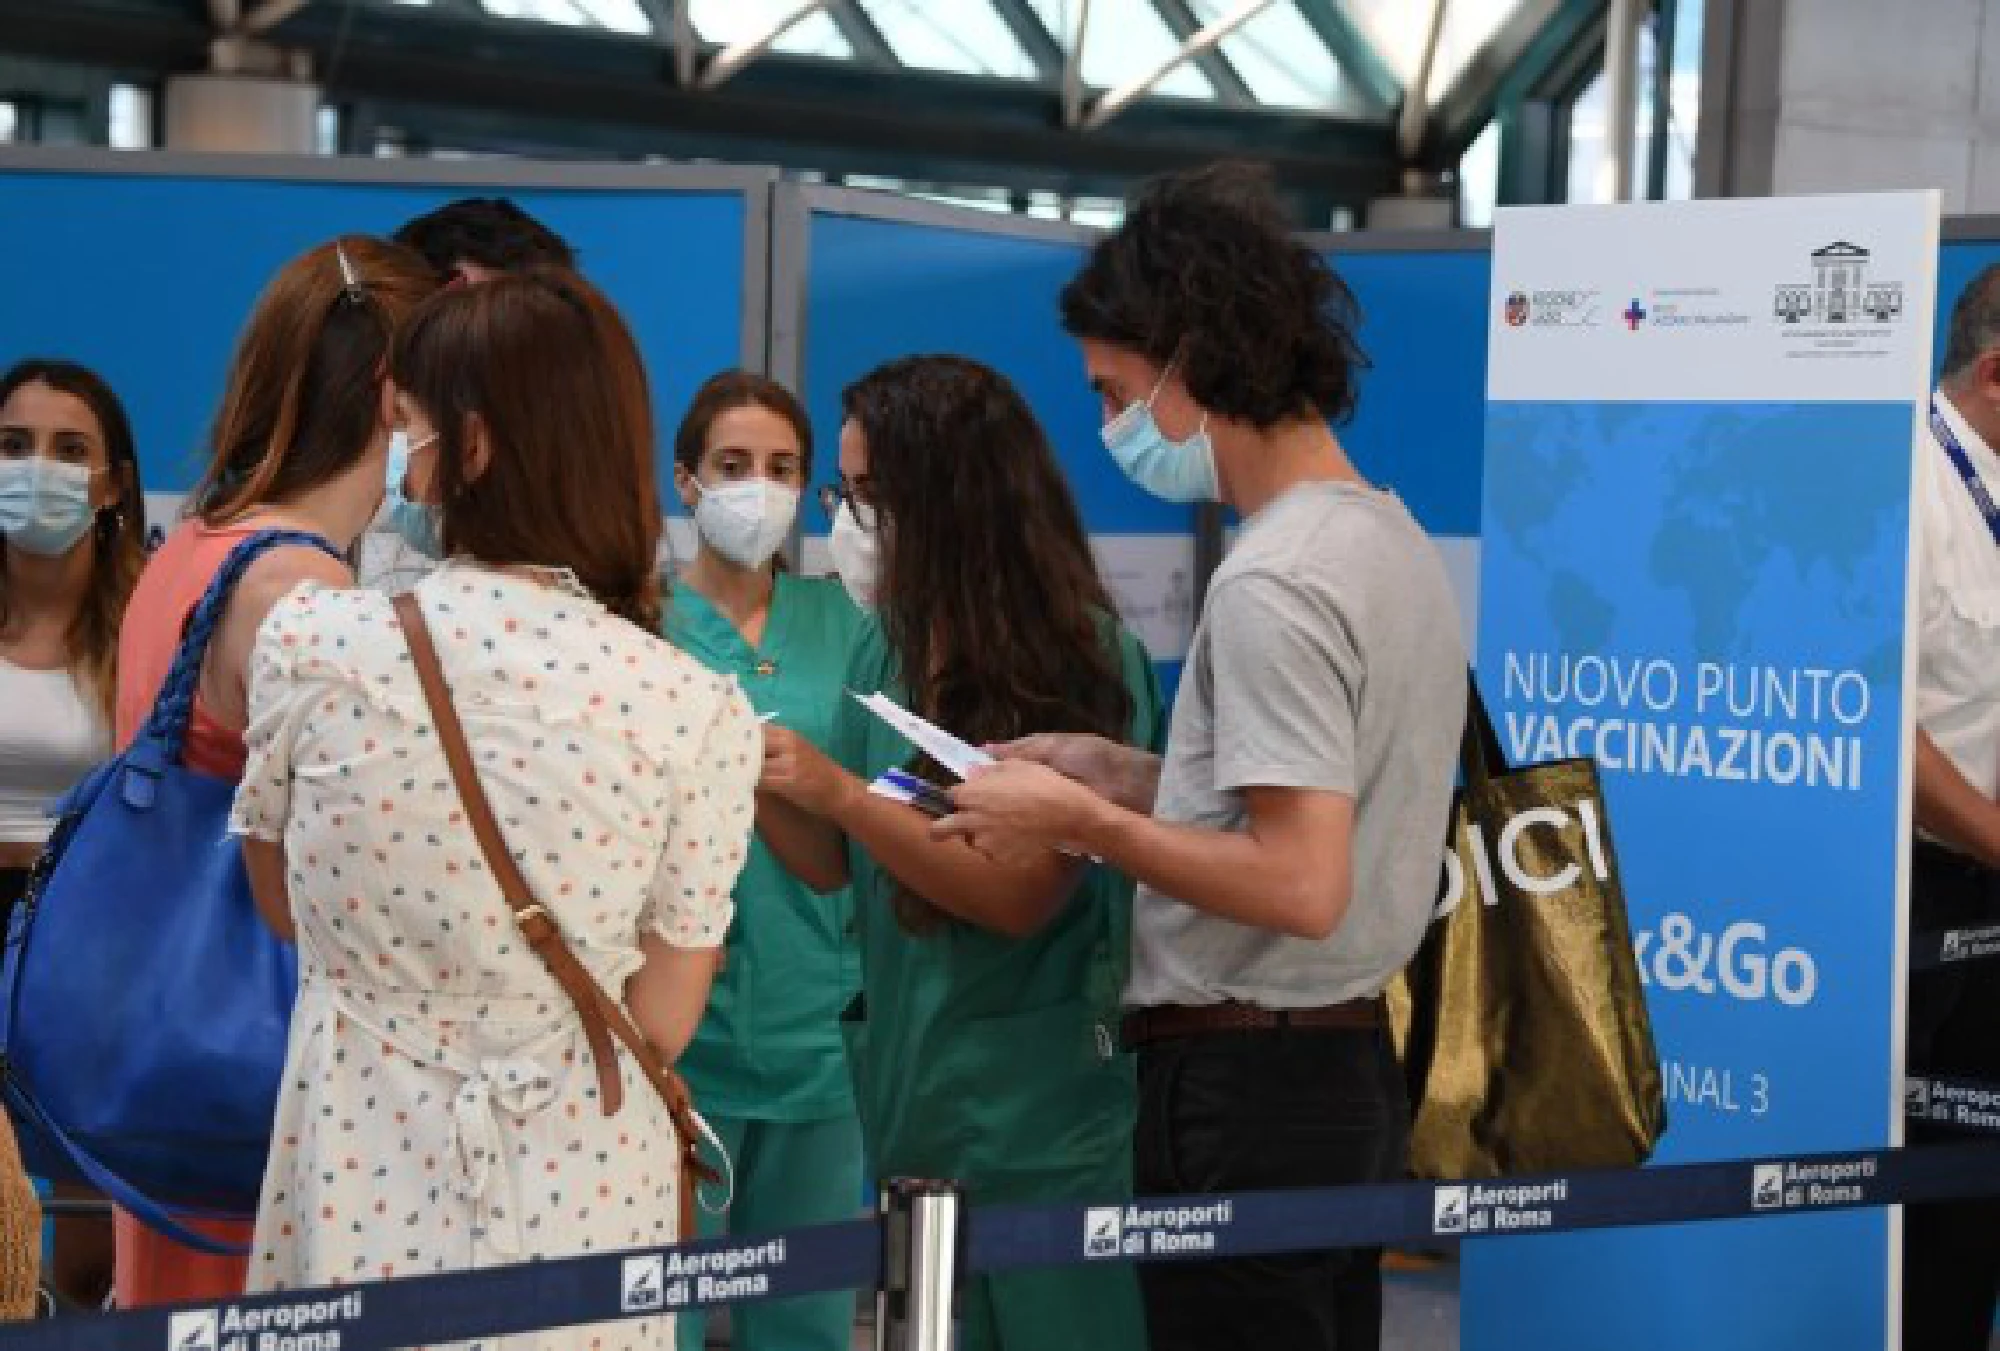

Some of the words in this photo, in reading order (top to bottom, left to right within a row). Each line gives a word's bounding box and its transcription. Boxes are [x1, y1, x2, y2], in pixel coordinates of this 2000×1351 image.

[1504, 650, 1678, 710] NUOVO
[1697, 662, 1871, 724] PUNTO
[1504, 711, 1862, 791] VACCINAZIONI
[1750, 1071, 1769, 1114] 3
[1786, 1158, 1877, 1184] Aeroporti
[1470, 1179, 1568, 1208] Aeroporti
[1786, 1183, 1804, 1205] di
[1809, 1182, 1862, 1205] Roma
[1124, 1199, 1233, 1232] Aeroporti
[1470, 1208, 1488, 1230] di
[1494, 1206, 1552, 1230] Roma
[666, 1236, 786, 1276] Aeroporti
[1123, 1231, 1145, 1254] di
[1151, 1228, 1215, 1253] Roma
[666, 1279, 689, 1305] di
[697, 1273, 768, 1302] Roma
[221, 1290, 362, 1333] Aeroporti
[259, 1329, 341, 1351] Roma
